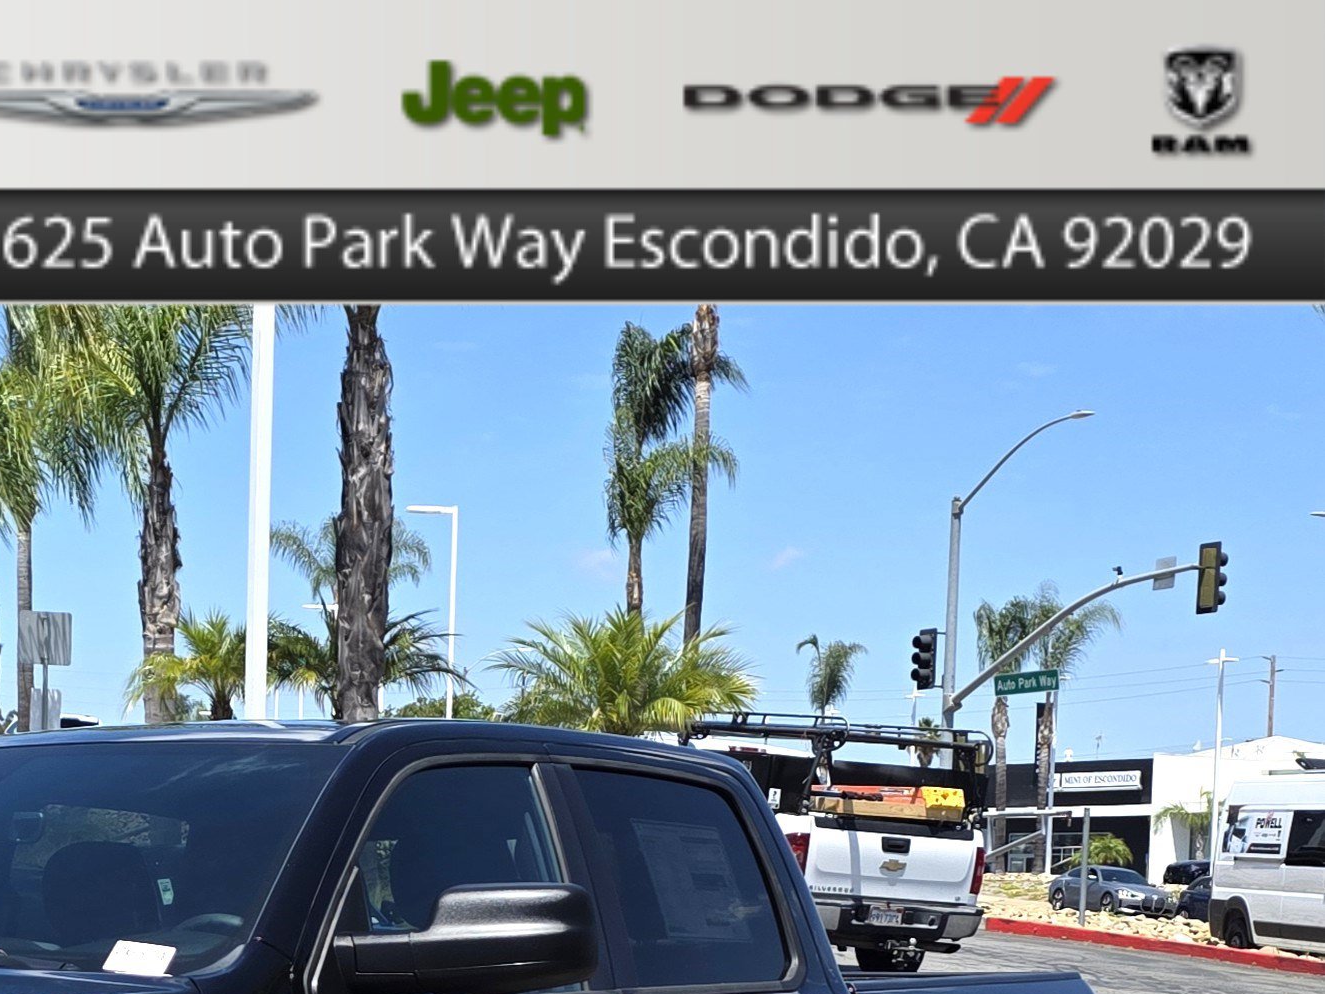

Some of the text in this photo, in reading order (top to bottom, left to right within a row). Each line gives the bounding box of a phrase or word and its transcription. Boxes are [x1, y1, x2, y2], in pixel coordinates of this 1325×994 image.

[997, 675, 1057, 691] Auto Park Way
[1083, 775, 1093, 784] OF
[1094, 774, 1137, 784] ESCONDIDO
